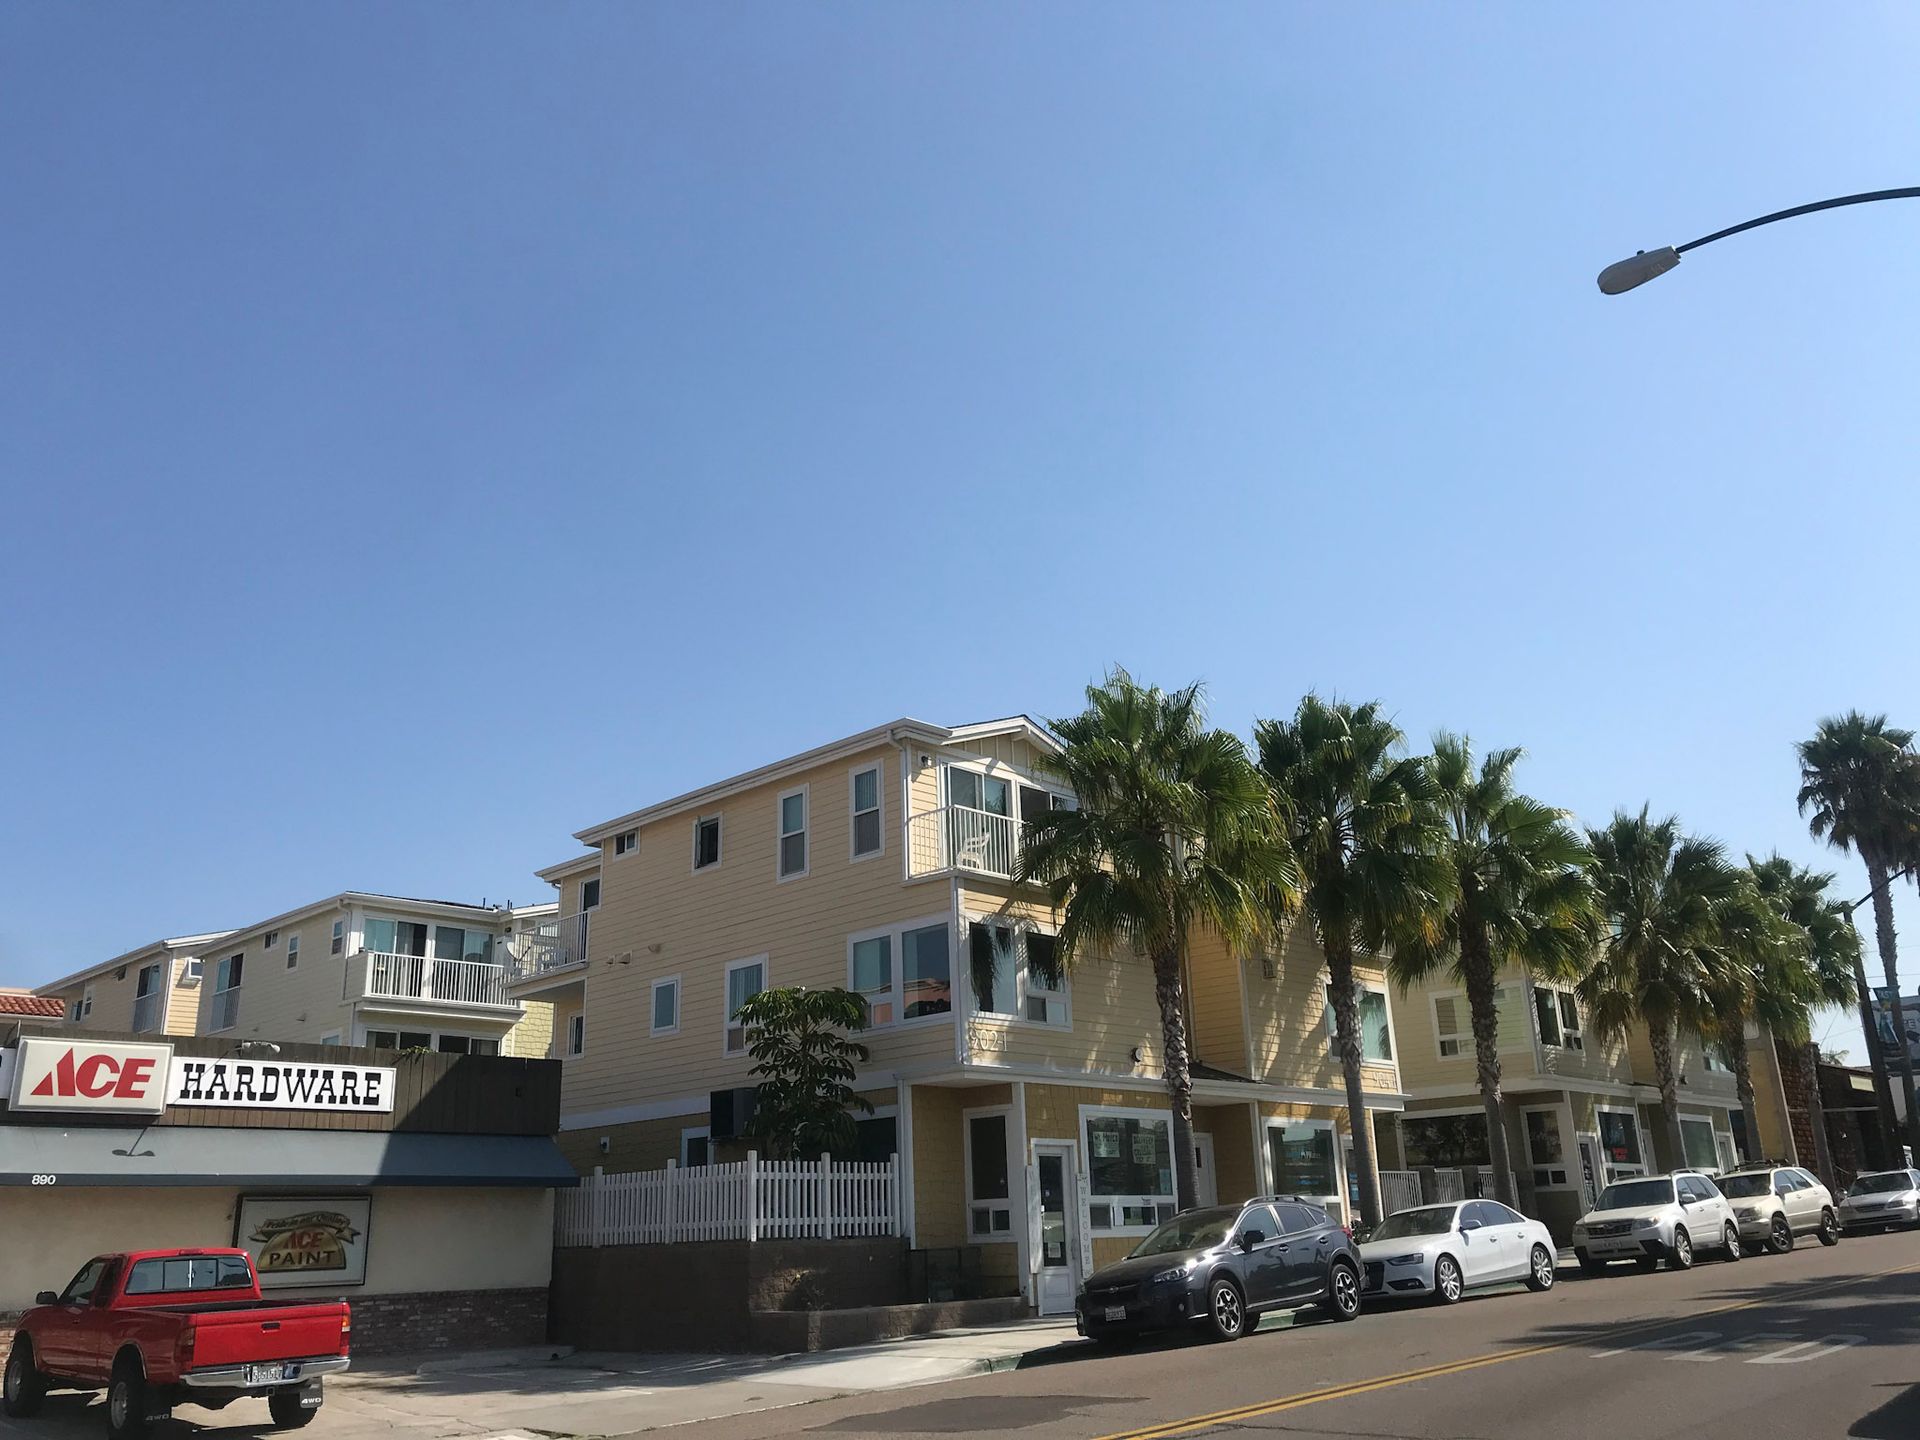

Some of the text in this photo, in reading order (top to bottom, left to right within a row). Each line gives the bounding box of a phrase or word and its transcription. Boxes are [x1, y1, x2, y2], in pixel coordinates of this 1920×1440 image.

[30, 1047, 382, 1106] ACE HARDWARE
[31, 1174, 57, 1186] 890
[1080, 1186, 1091, 1265] WELCOME
[283, 1231, 324, 1249] ACE
[269, 1250, 336, 1265] PAINT
[1588, 1331, 1869, 1365] PED
[301, 1397, 322, 1405] 4WD
